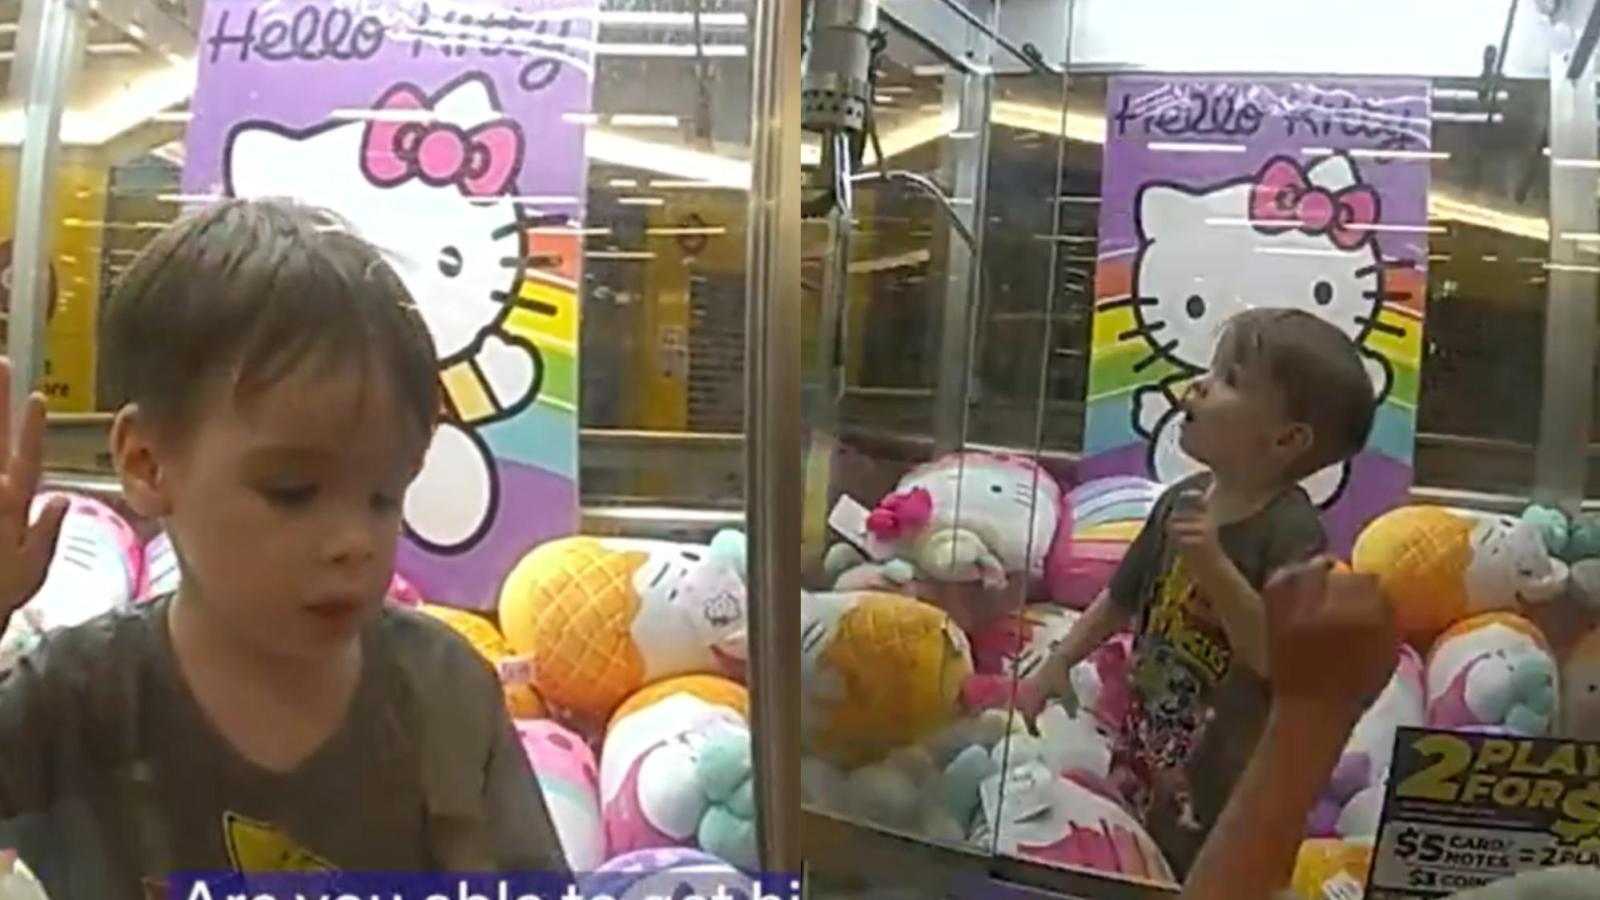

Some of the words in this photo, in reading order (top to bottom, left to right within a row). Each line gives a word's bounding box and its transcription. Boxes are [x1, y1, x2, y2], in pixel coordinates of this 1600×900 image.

[207, 5, 386, 62] Hello
[1114, 94, 1264, 137] Hello
[1396, 735, 1471, 800] 2
[1461, 774, 1565, 808] FOR
[1394, 826, 1445, 864] $5
[1444, 850, 1512, 868] NOTES
[1540, 847, 1557, 866] 2
